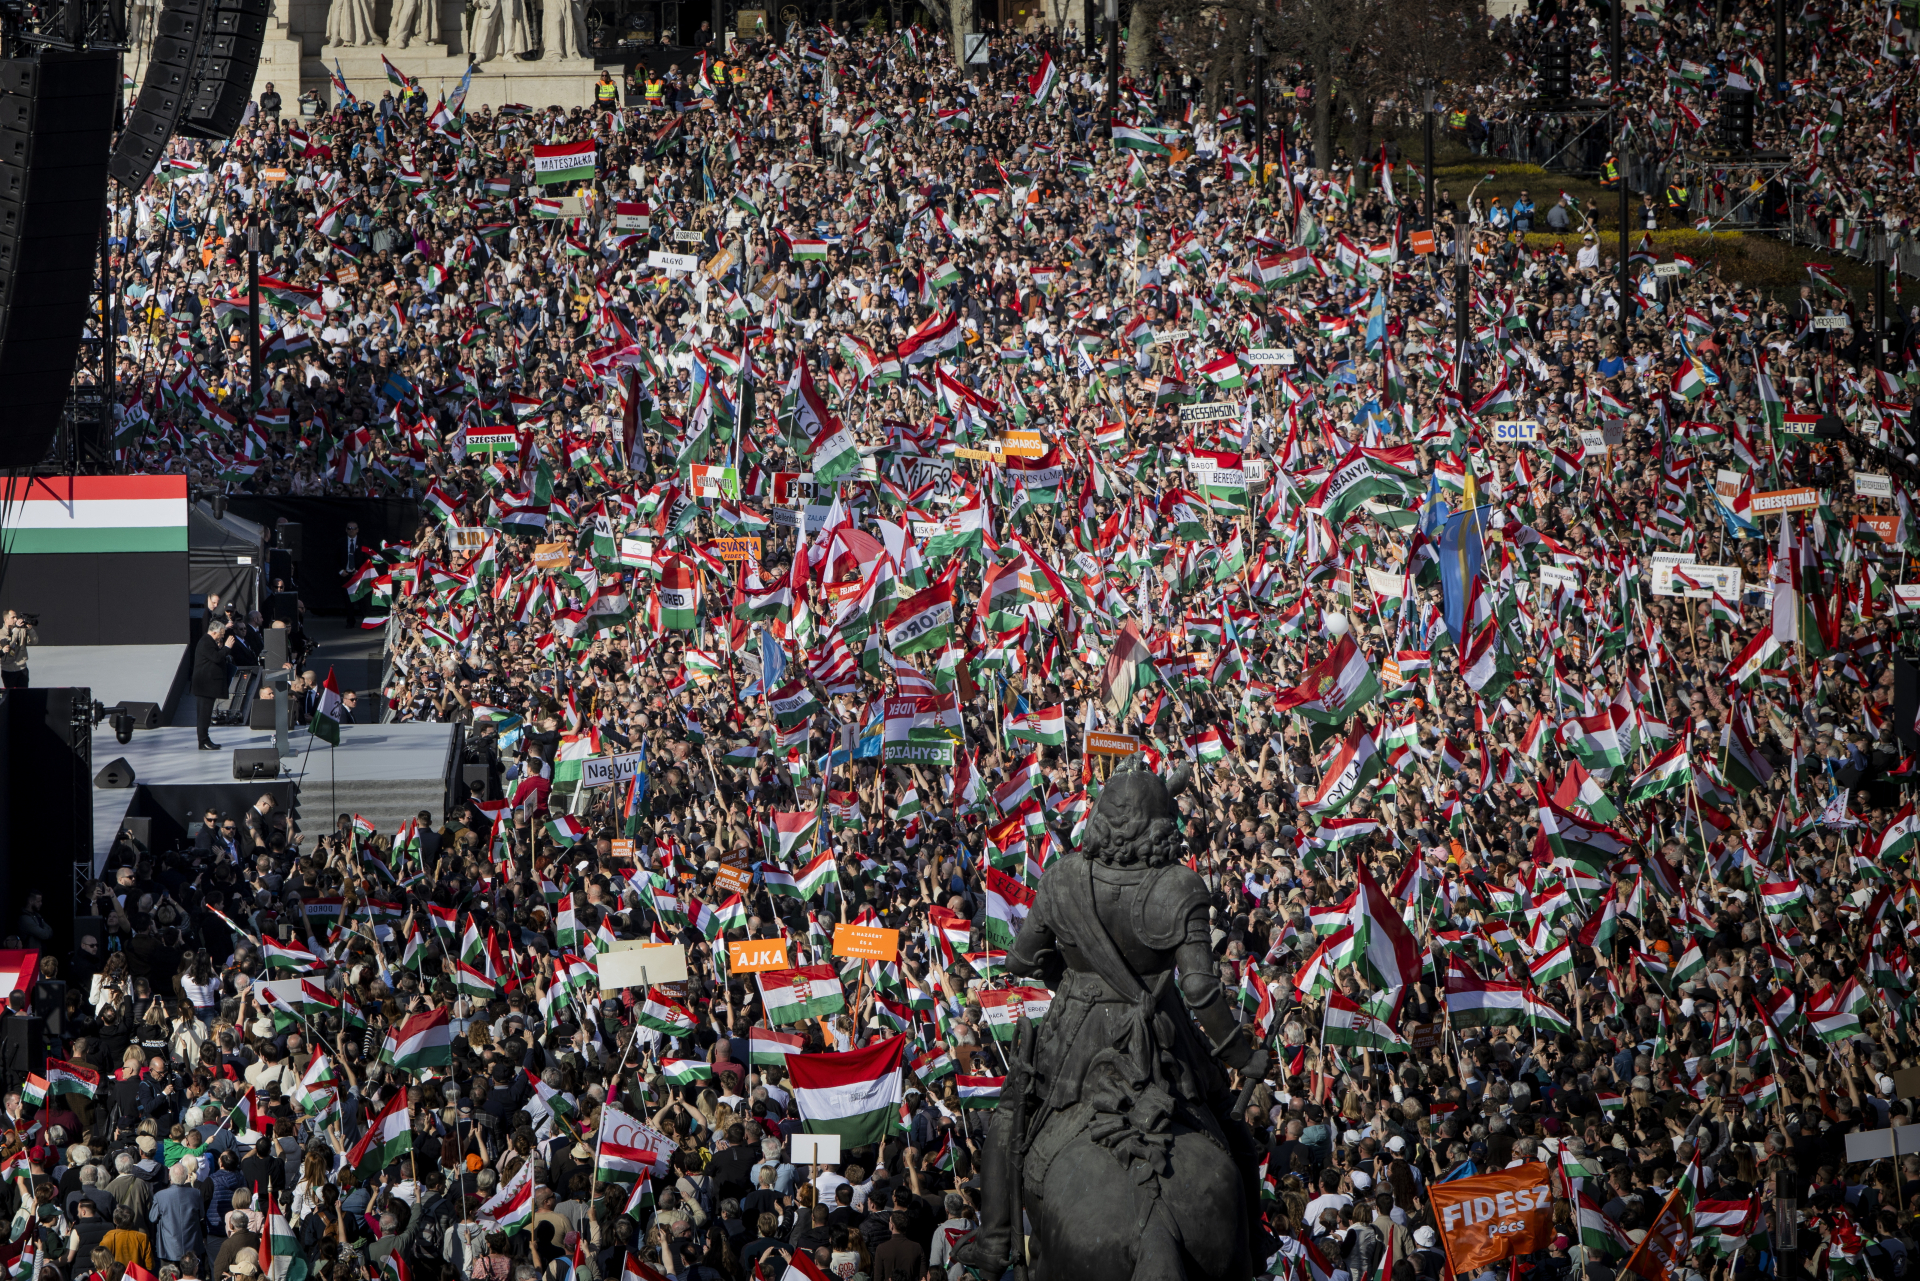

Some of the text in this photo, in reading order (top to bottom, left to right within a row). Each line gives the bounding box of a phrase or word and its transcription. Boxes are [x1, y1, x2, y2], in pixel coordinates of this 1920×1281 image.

[541, 154, 593, 171] MÁTÉSZALKA
[661, 256, 683, 266] ALGYŐ
[1657, 265, 1676, 273] PÉCS
[1249, 352, 1286, 361] BODAJK
[1497, 424, 1536, 438] SOLT
[1784, 422, 1815, 433] HEVE
[469, 435, 513, 444] SZÉCSÉNY
[1000, 437, 1042, 450] KISMAROS
[1190, 460, 1214, 470] BABÓT
[1752, 489, 1817, 510] VERESEGYHÁZ
[1091, 736, 1135, 752] RÁKOSMENTE
[588, 755, 638, 780] Nagyút
[1327, 760, 1361, 806] GYULA
[719, 867, 739, 878] FIDESZ
[721, 876, 741, 887] BIZTOS
[737, 949, 784, 968] AJKA
[1026, 1006, 1049, 1014] ERDÉLY
[1442, 1184, 1551, 1233] FIDESZ
[838, 1262, 855, 1273] GOD
